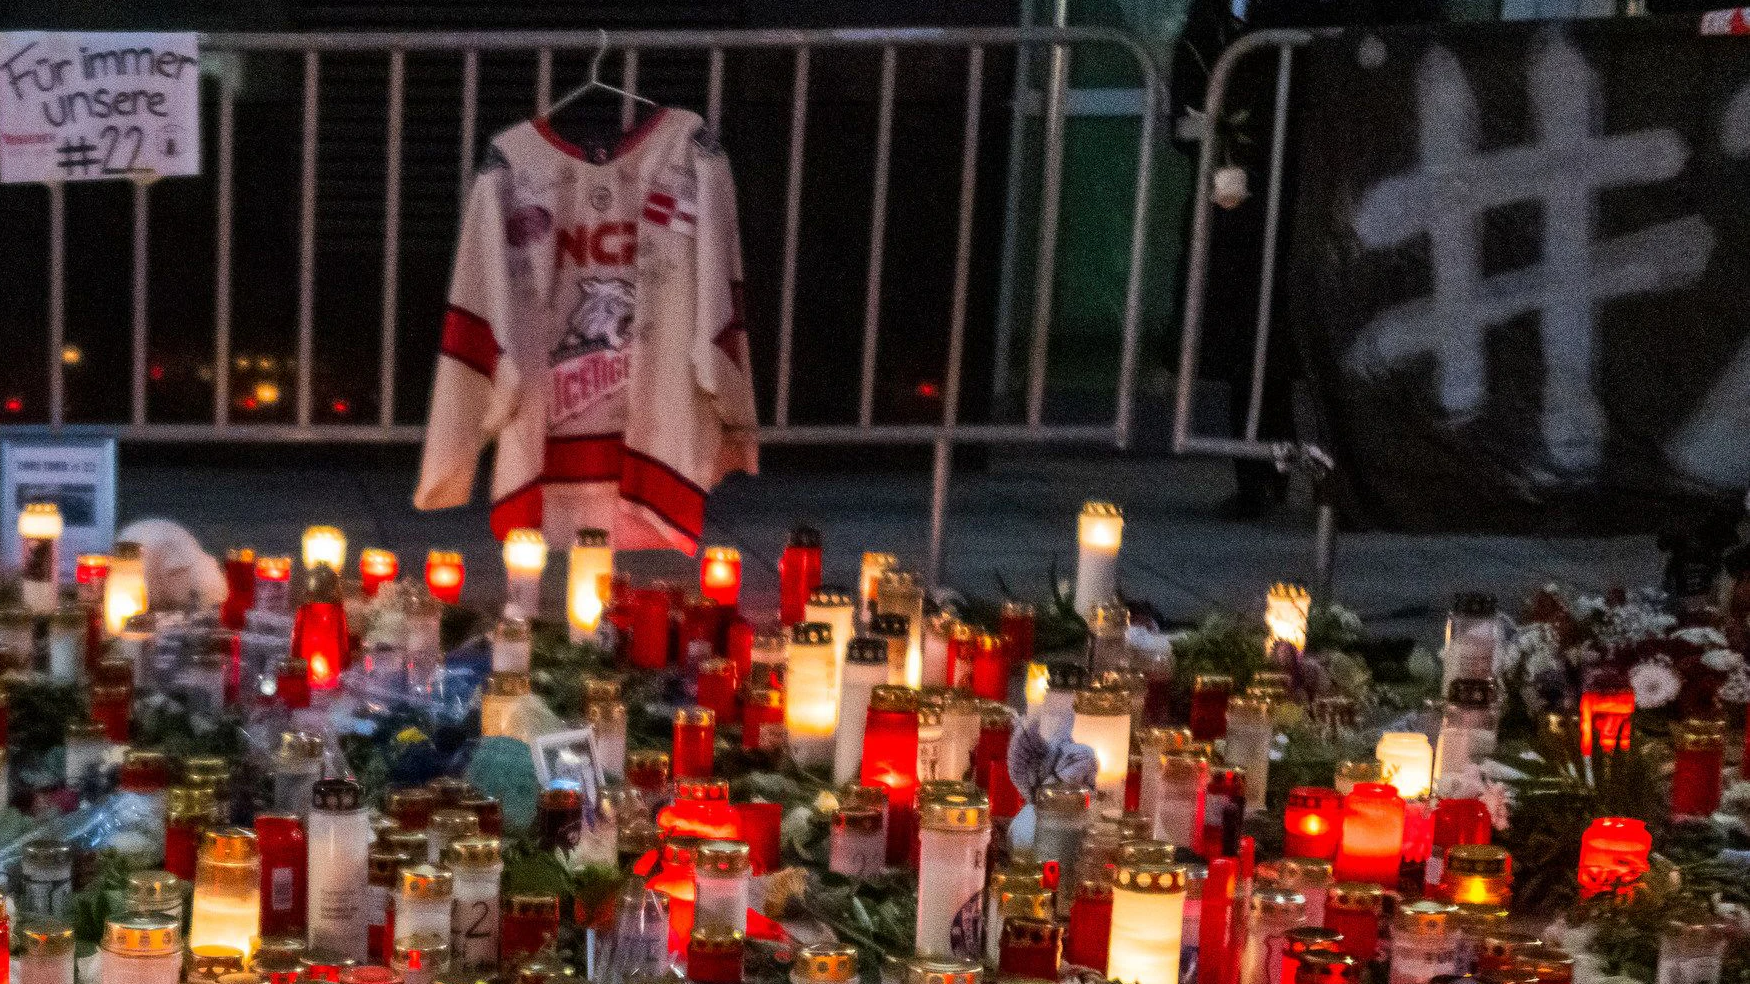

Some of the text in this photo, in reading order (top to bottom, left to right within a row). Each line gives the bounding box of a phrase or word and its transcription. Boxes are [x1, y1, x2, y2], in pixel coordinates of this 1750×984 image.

[0, 41, 199, 100] Für immer
[42, 86, 169, 127] unsere
[56, 125, 156, 176] #22
